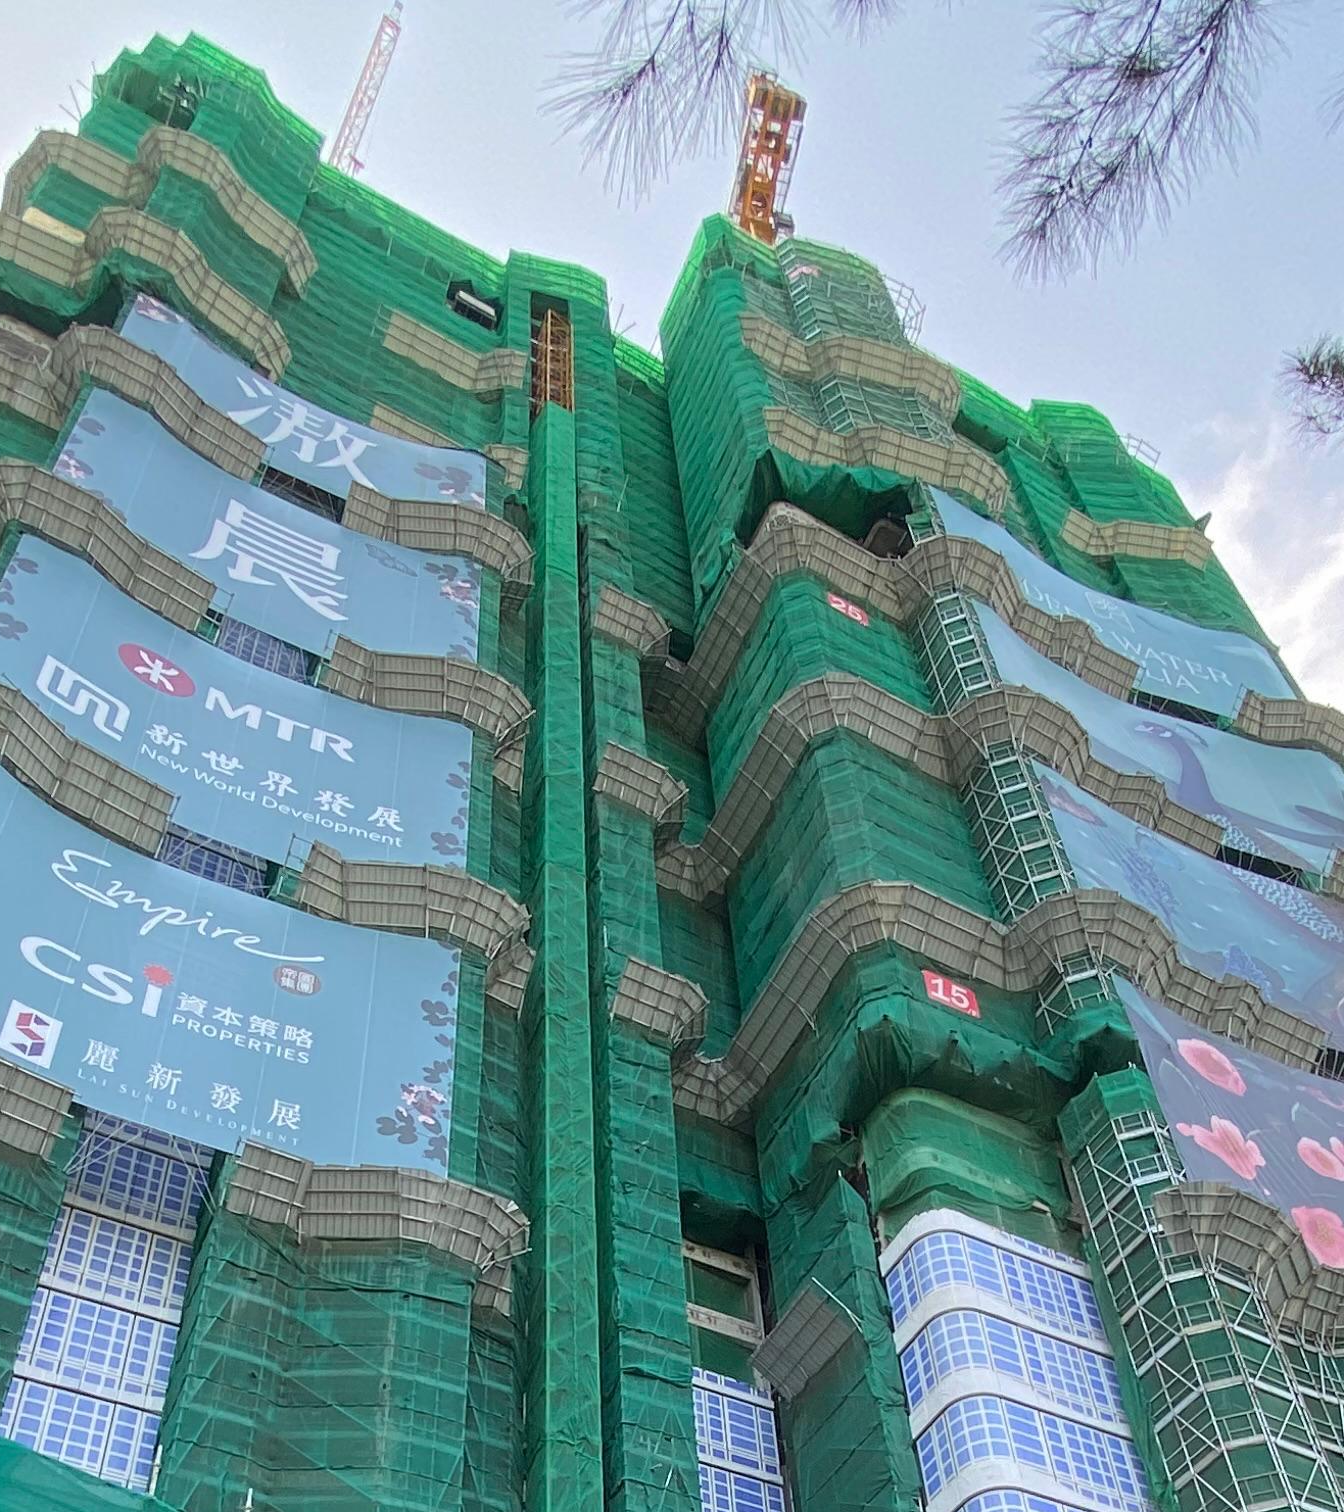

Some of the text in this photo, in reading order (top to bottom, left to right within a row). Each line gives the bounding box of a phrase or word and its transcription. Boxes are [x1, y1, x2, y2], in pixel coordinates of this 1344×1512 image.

[1111, 631, 1233, 687] WATER
[205, 686, 355, 763] MTR
[140, 743, 403, 848] New World Development
[145, 723, 405, 833] 新世界發展
[51, 849, 325, 962] Empire
[172, 1014, 311, 1065] PROPERTIES
[176, 991, 314, 1050] 資本策略
[81, 1038, 301, 1131] 麗新發展
